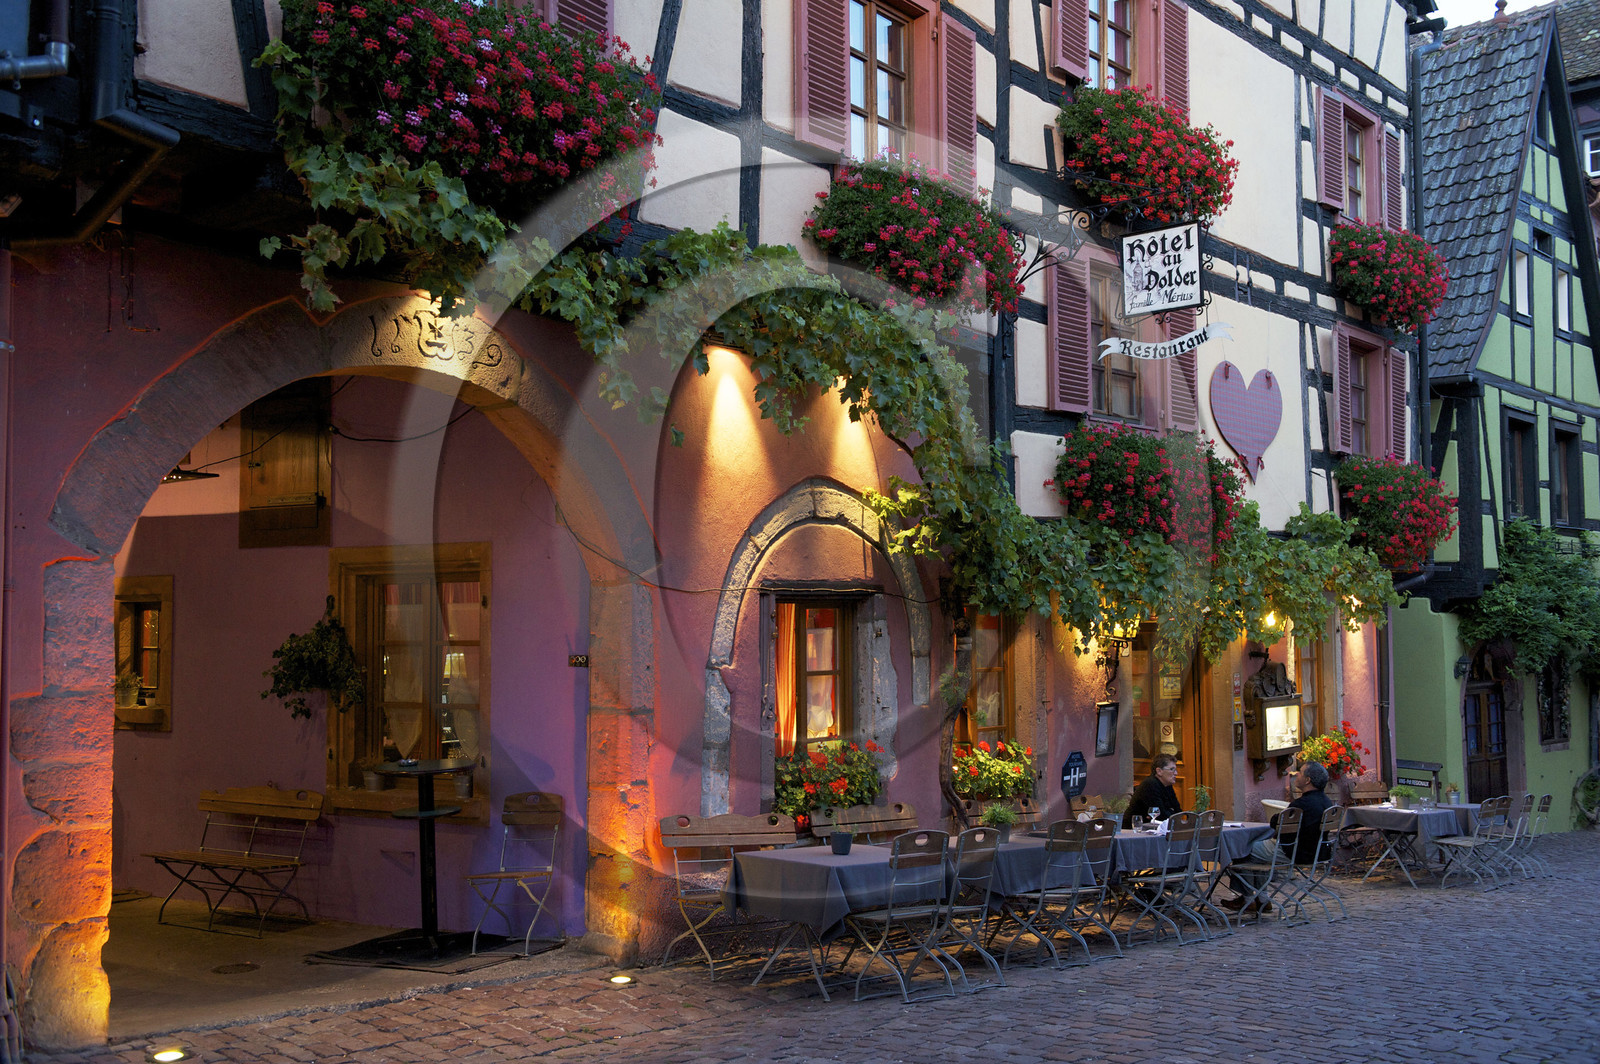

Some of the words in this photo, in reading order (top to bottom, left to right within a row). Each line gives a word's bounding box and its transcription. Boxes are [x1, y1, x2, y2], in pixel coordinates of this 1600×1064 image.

[1126, 227, 1195, 263] Hôtel
[1163, 254, 1182, 267] au
[1144, 265, 1197, 291] Dolder
[1120, 328, 1210, 359] Restaurant
[1071, 767, 1080, 787] H
